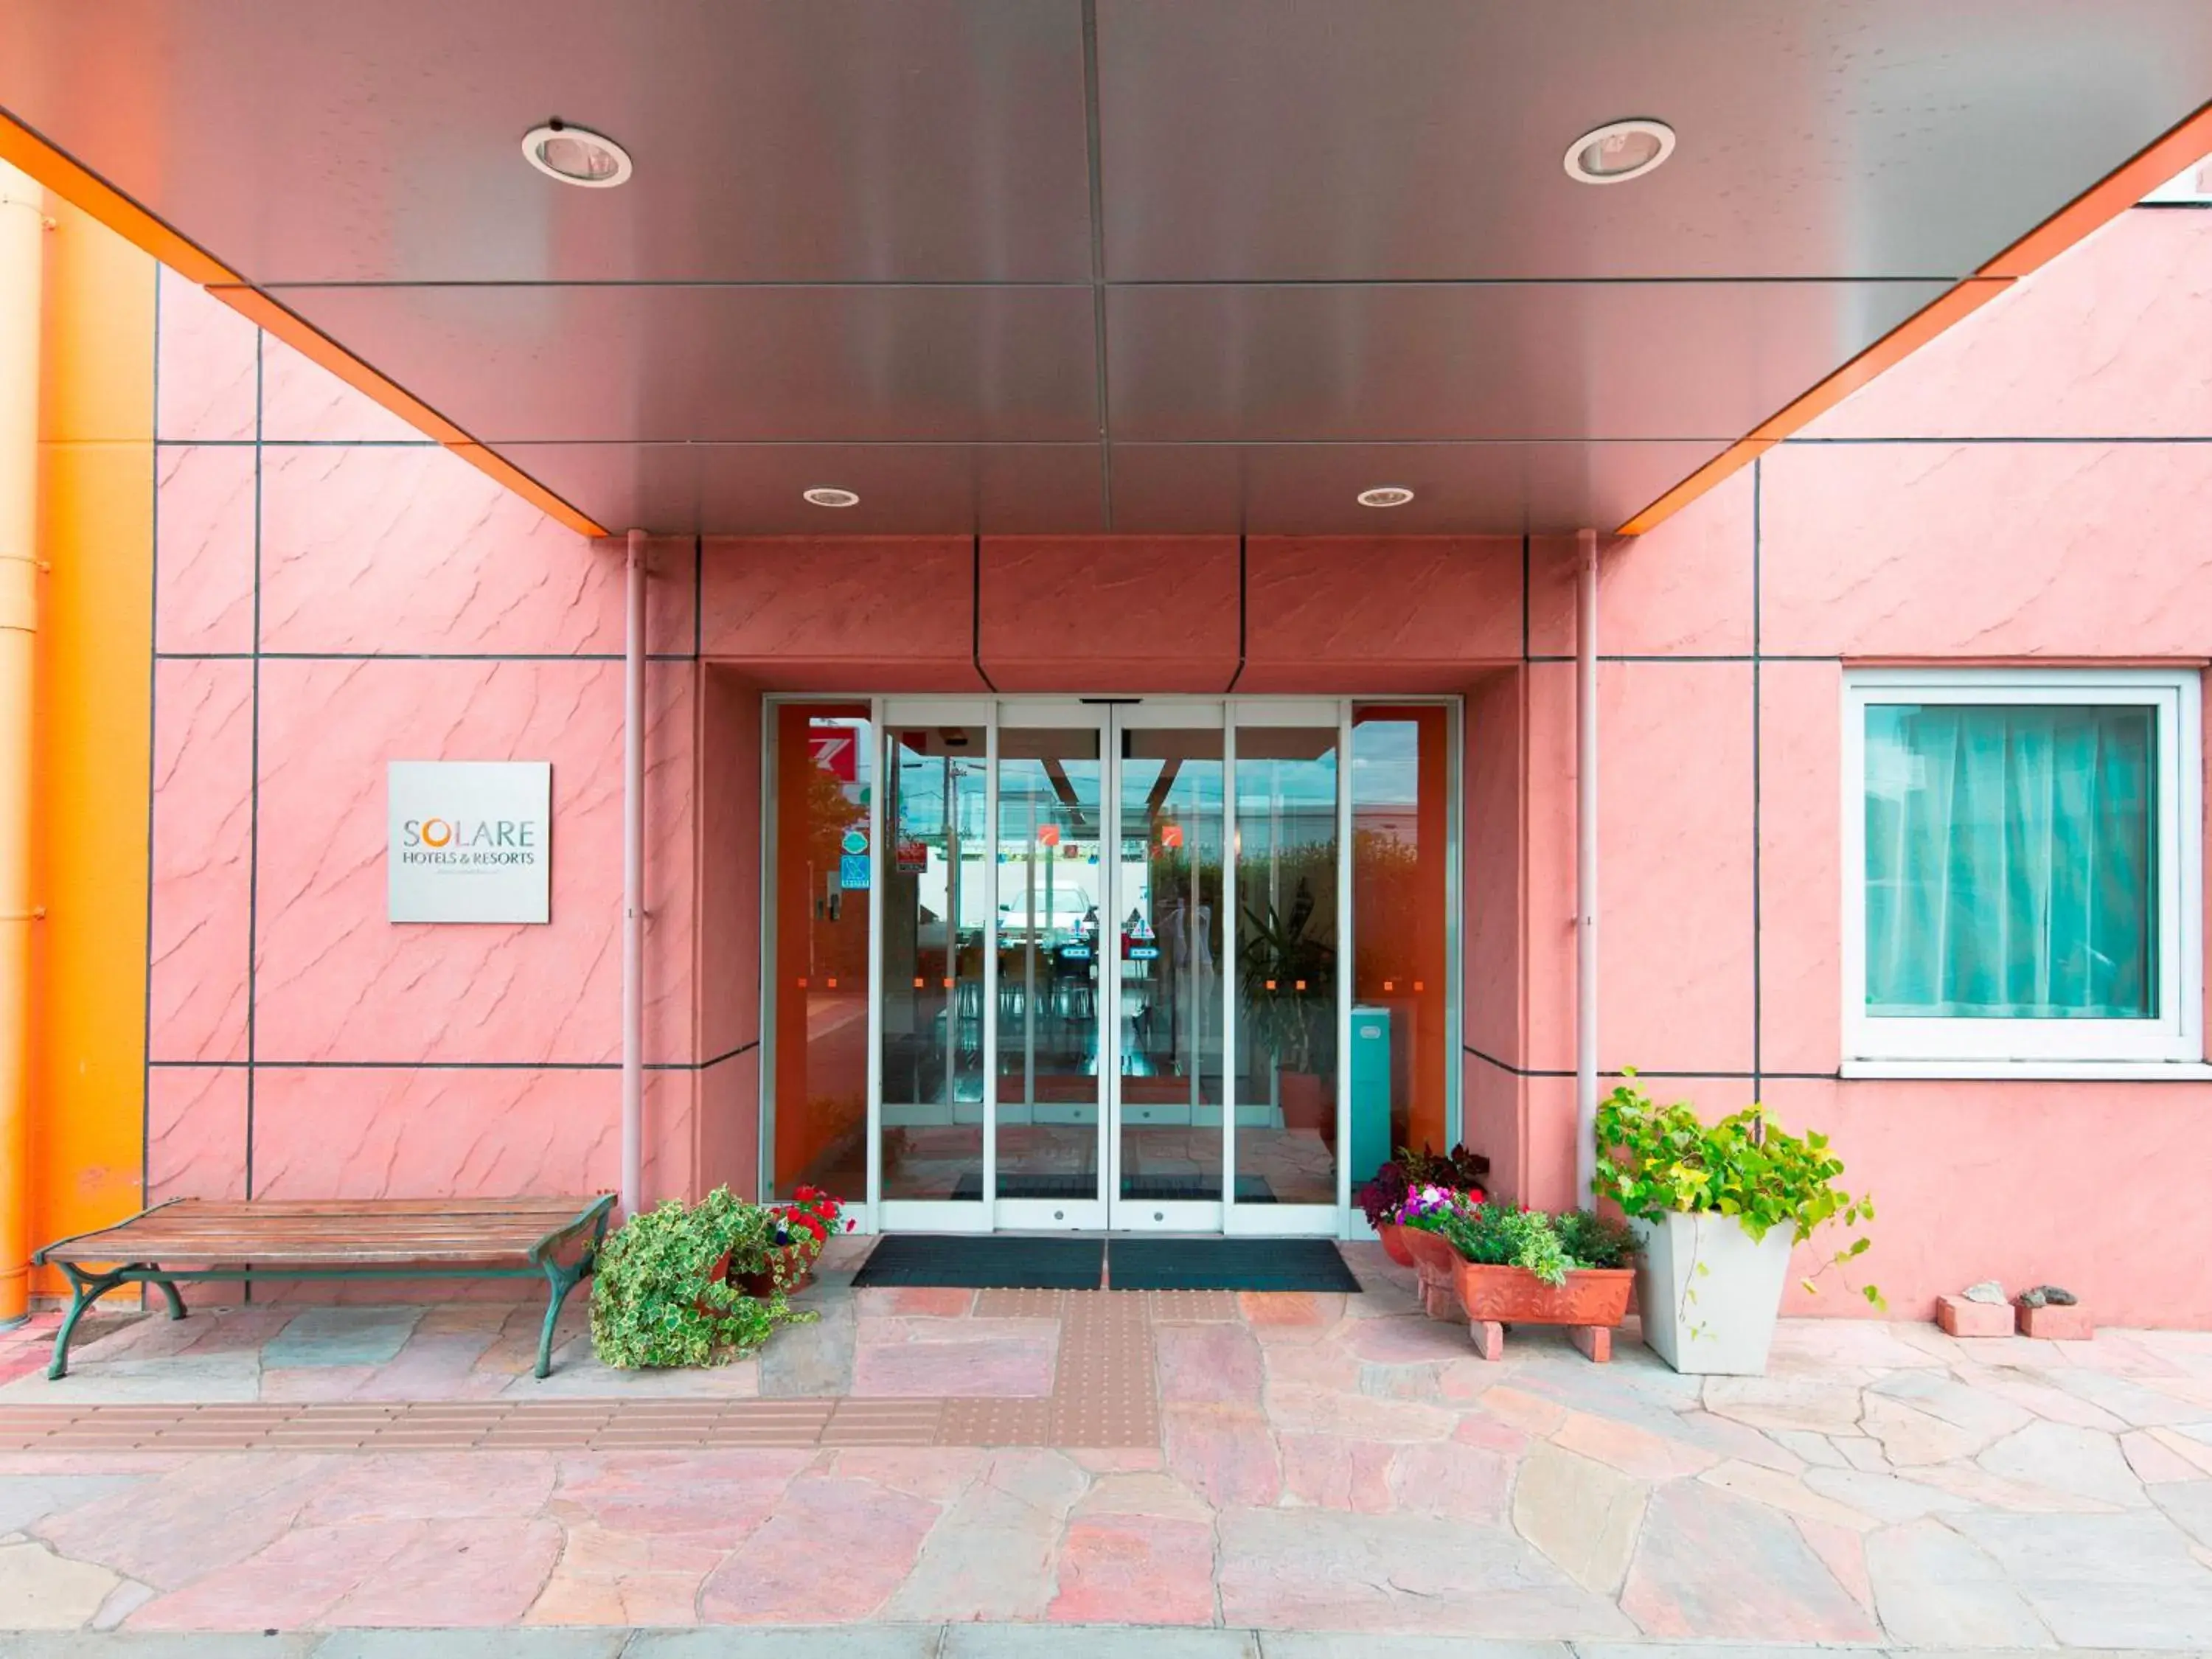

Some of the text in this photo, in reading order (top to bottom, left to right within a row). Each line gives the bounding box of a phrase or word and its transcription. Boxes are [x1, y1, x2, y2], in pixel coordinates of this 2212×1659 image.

[403, 818, 535, 848] SOLARE
[403, 852, 535, 865] HOTELS & RESORTS
